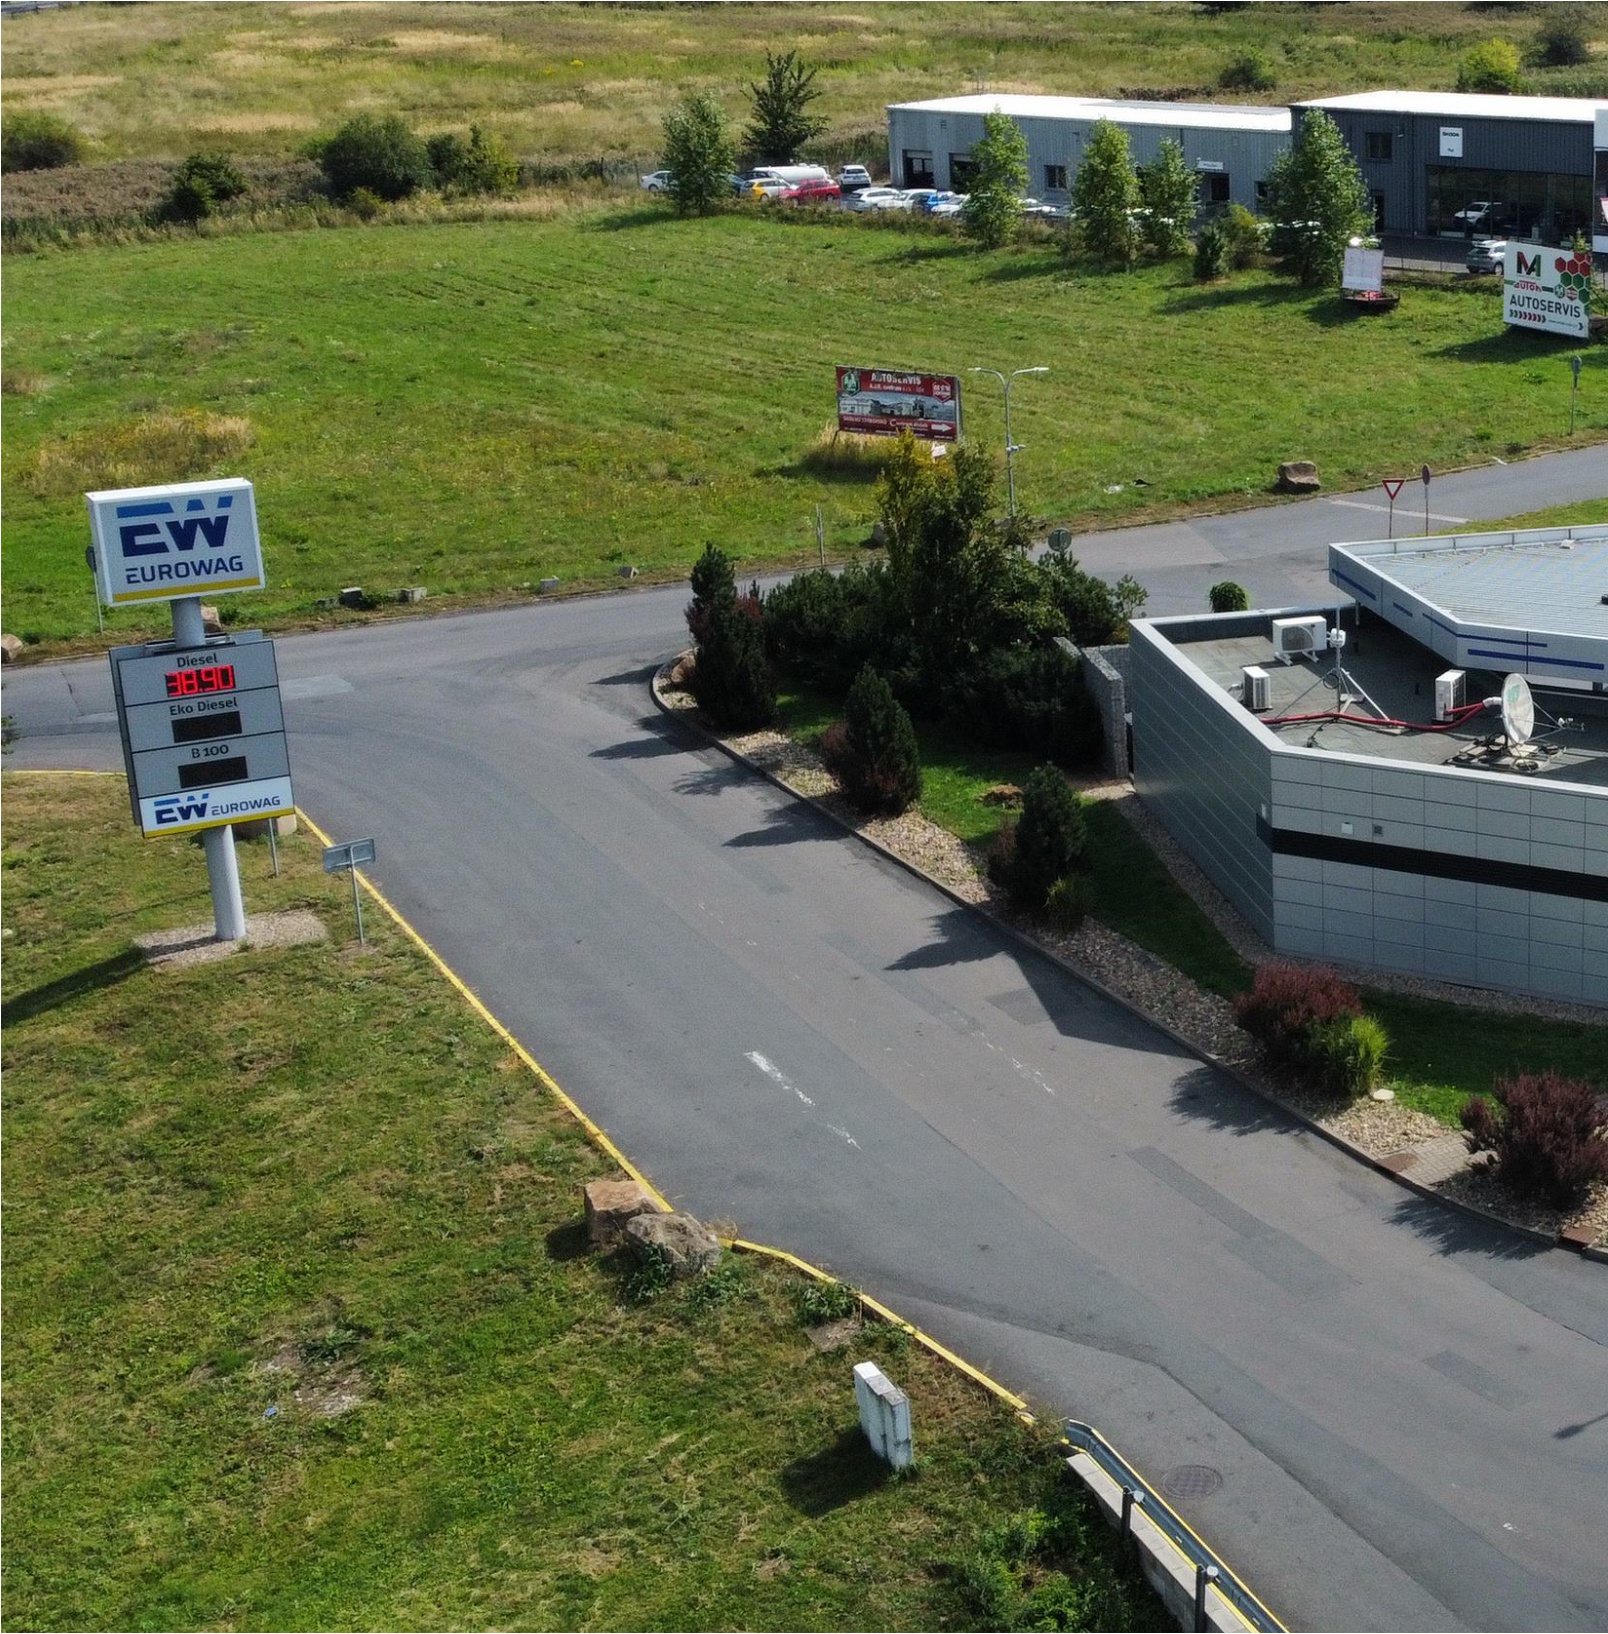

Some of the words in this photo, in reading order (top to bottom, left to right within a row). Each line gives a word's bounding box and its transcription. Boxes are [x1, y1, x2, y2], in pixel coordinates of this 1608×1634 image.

[1509, 294, 1581, 319] AUTOSERVIS
[116, 495, 233, 558] EW
[125, 554, 244, 585] EUROWAG
[176, 652, 218, 668] Diesel
[166, 664, 235, 698] 38.90
[169, 704, 194, 717] Eko
[197, 697, 238, 713] Diesel
[191, 747, 200, 758] B
[203, 743, 229, 757] 100
[154, 792, 210, 825] EW
[211, 795, 281, 817] EUROWAG
